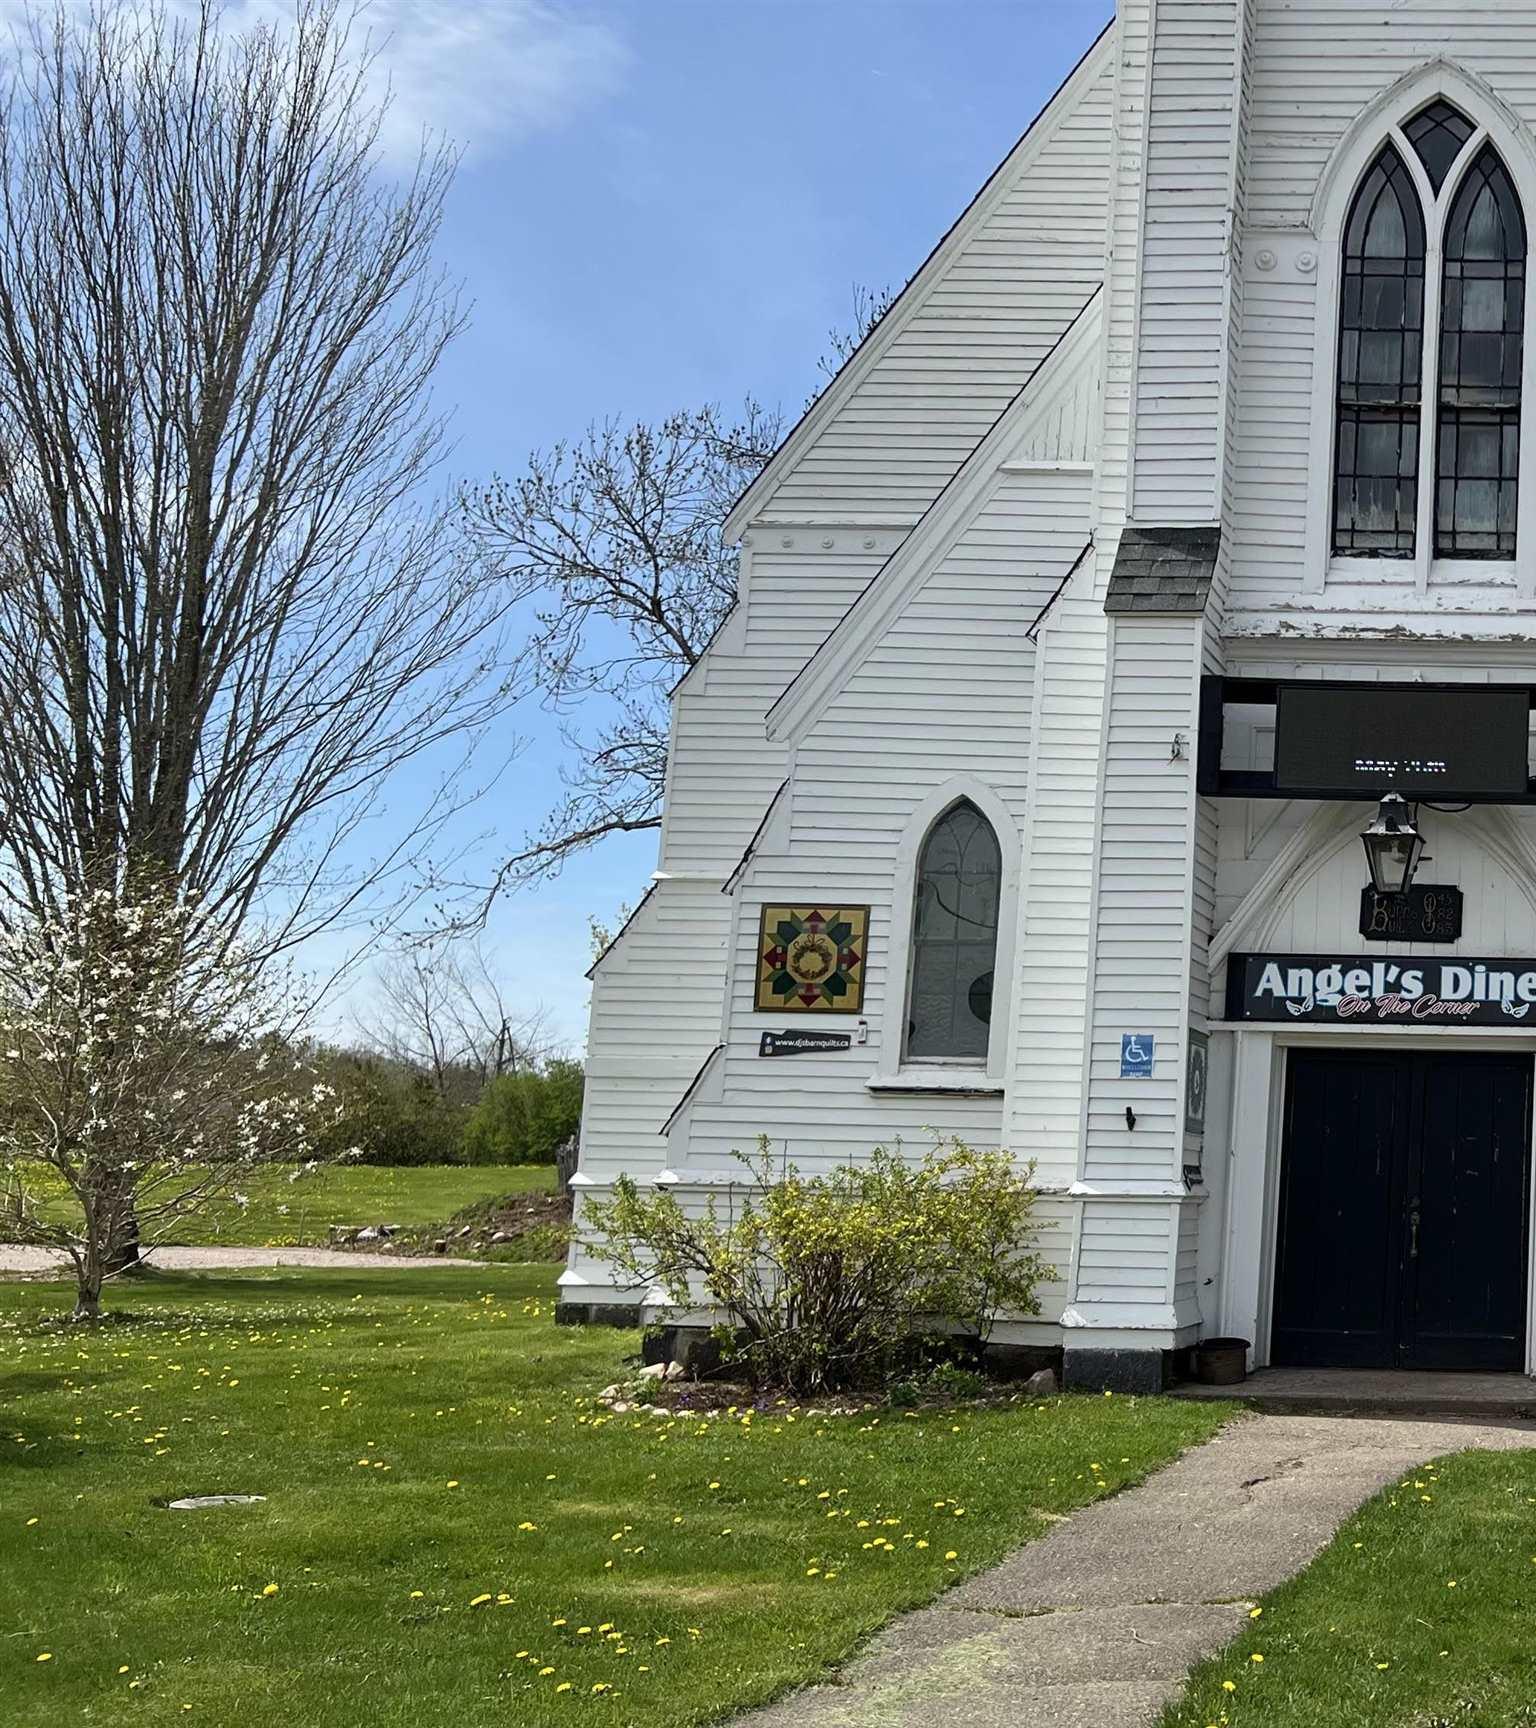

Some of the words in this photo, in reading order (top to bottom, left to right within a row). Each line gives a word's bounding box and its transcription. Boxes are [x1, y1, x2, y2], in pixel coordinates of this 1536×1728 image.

[1253, 962, 1425, 1006] Angel's
[1336, 994, 1371, 1017] On
[1375, 993, 1410, 1018] The
[1411, 994, 1481, 1018] Corner
